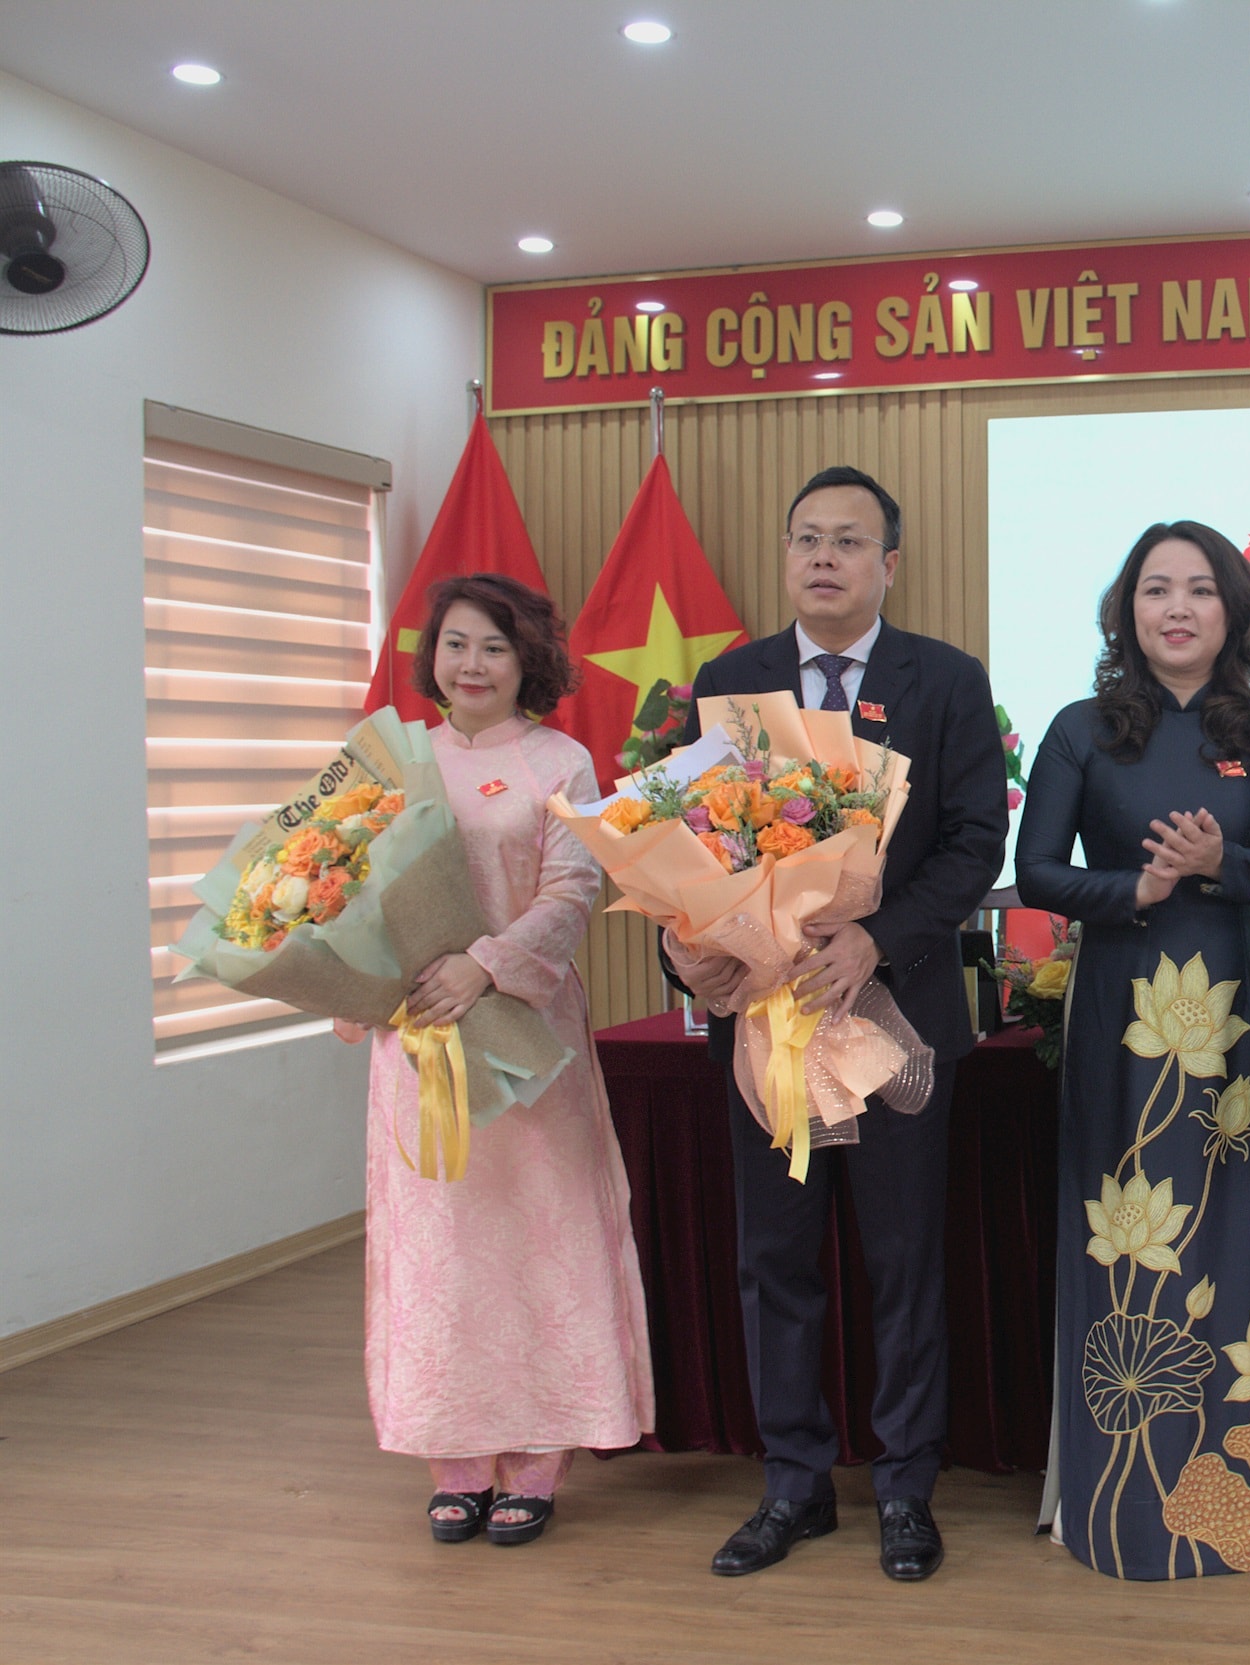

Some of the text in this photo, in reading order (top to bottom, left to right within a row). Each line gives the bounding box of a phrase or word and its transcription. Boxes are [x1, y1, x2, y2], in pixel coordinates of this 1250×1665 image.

[541, 297, 685, 379] ĐẢNG
[705, 291, 852, 379] CỘNG
[873, 272, 992, 356] SẢN
[1016, 269, 1139, 361] VIỆT
[277, 794, 321, 833] The
[319, 758, 349, 796] Old
